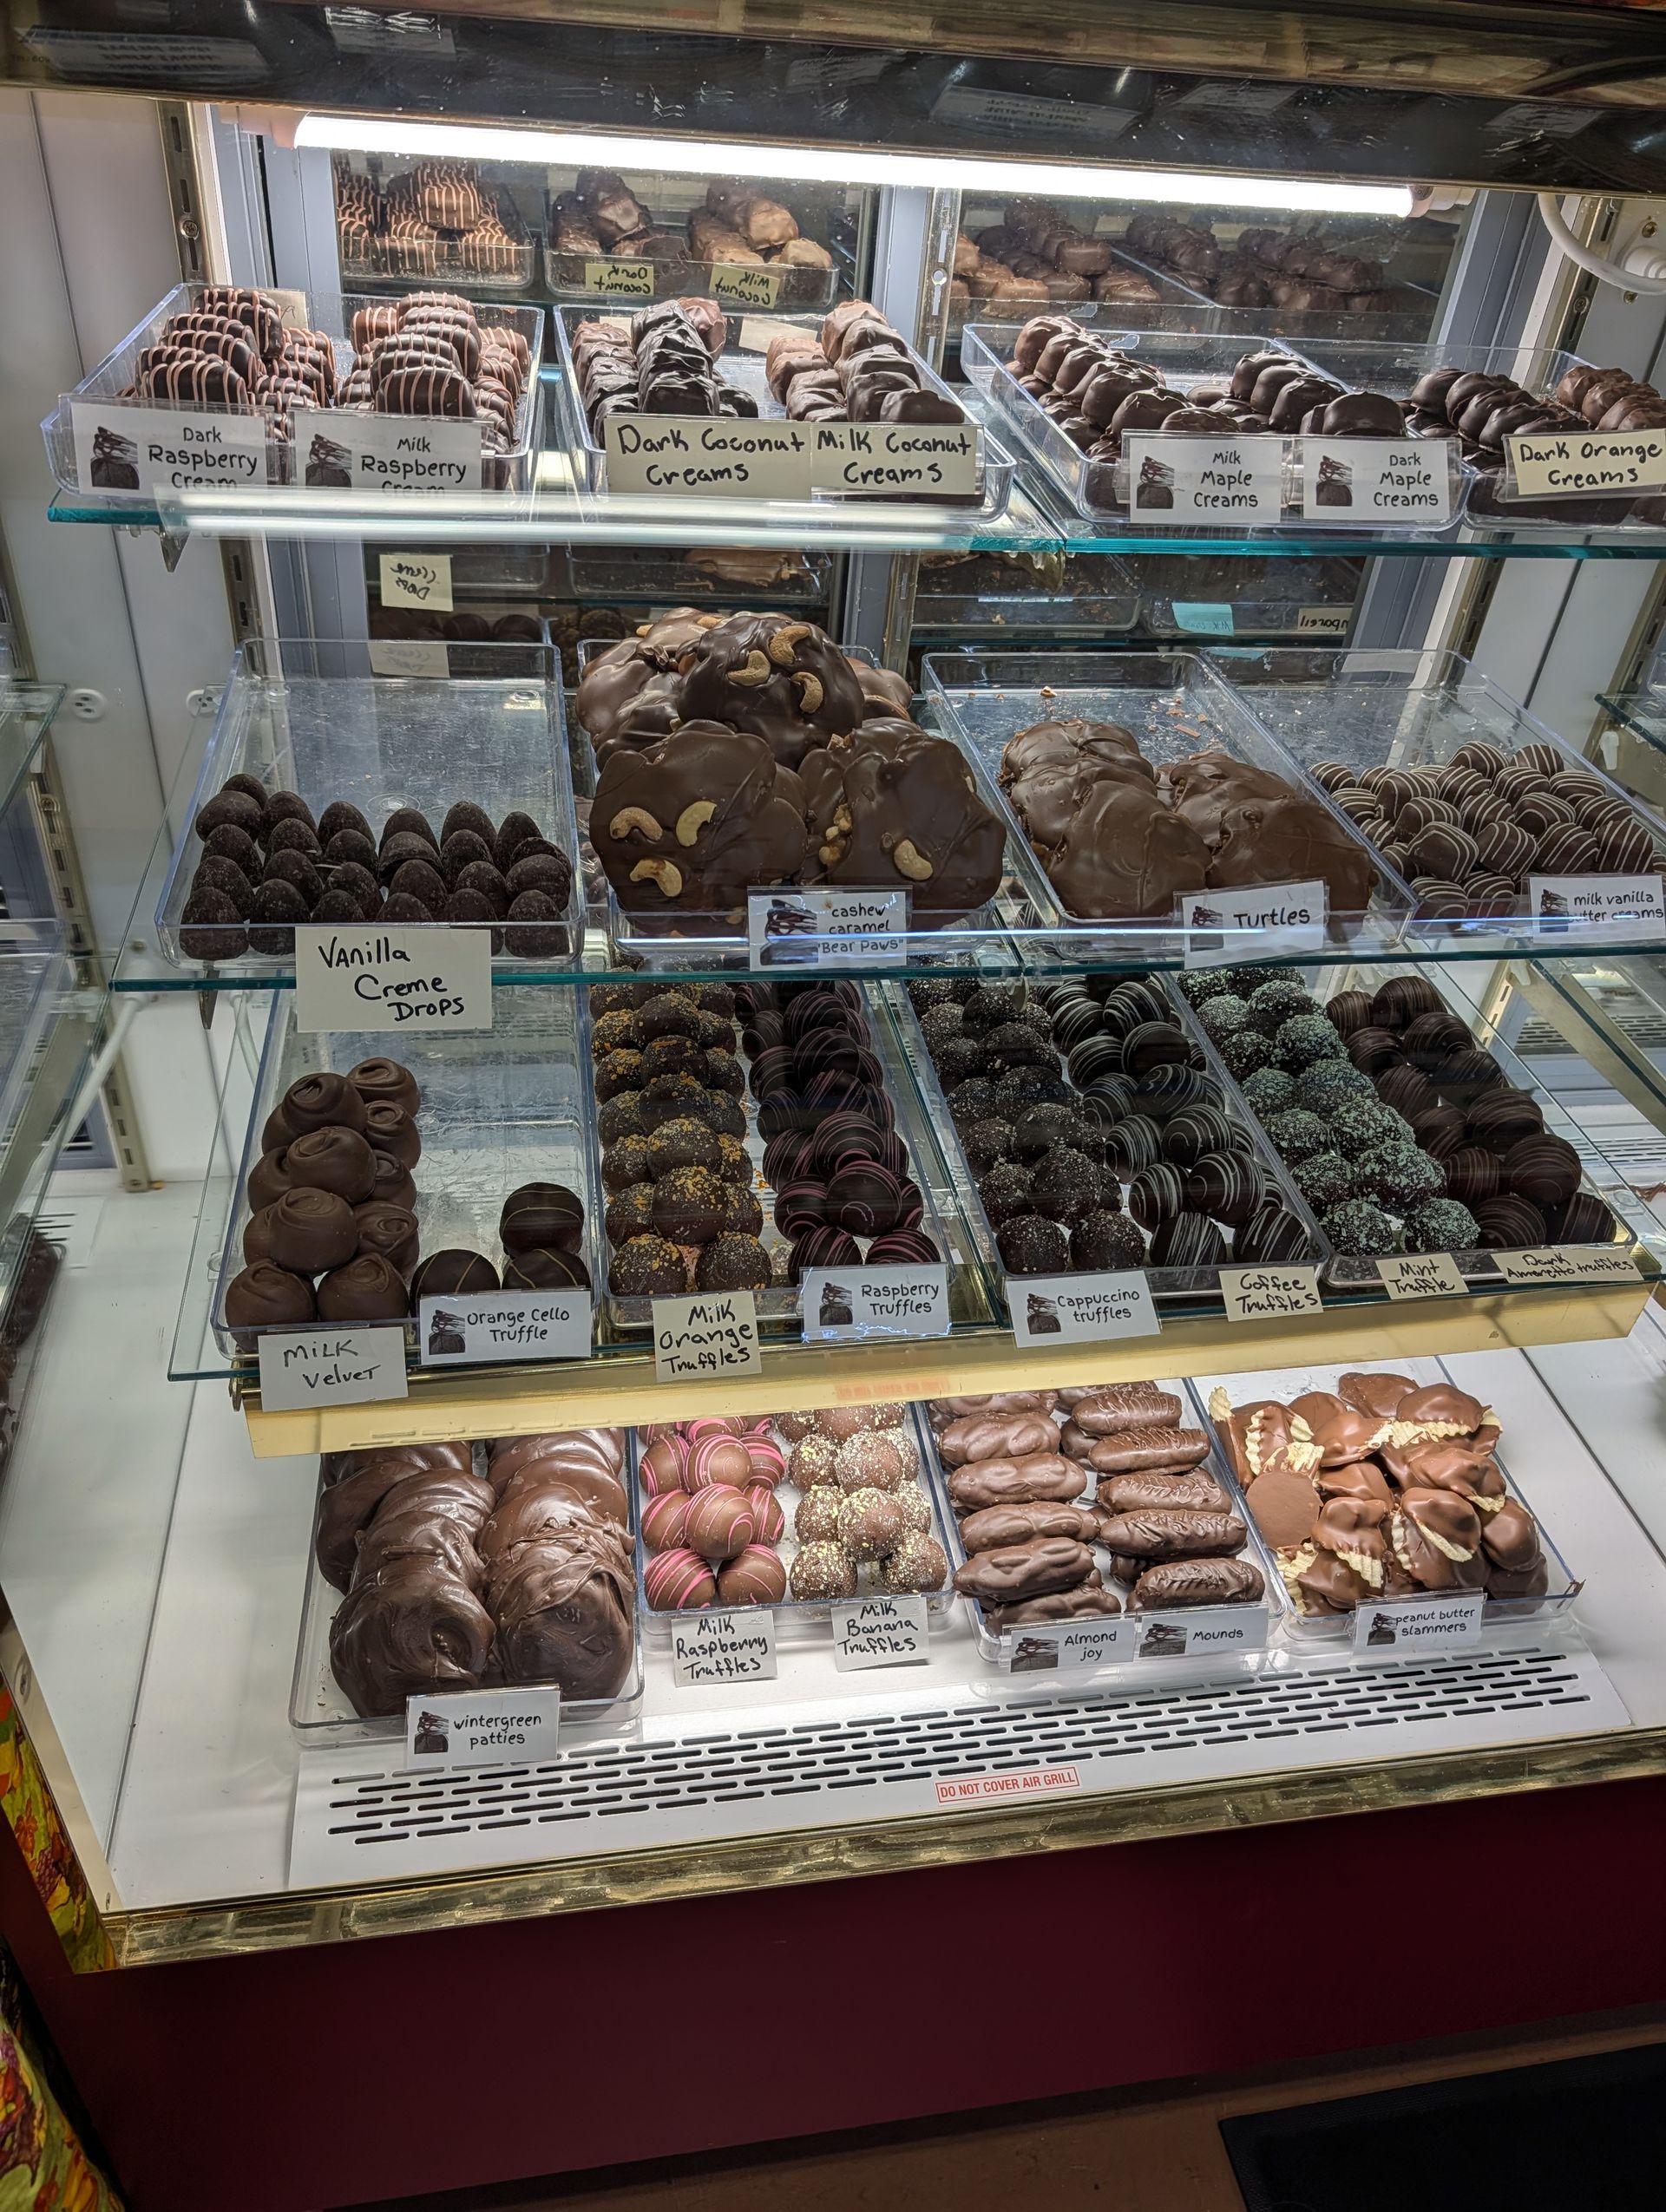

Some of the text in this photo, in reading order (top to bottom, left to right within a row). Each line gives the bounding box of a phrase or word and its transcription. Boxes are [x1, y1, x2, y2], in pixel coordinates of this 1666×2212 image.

[183, 426, 222, 443] Dark
[617, 424, 805, 456] Dark Coconut
[817, 428, 972, 456] Milk Coconut
[397, 436, 431, 453] Milk
[1519, 441, 1663, 463] Dark Orange
[148, 444, 258, 475] Raspberry
[1212, 450, 1242, 465] Milk
[1389, 453, 1421, 467] Dark
[361, 455, 467, 483] Raspberry
[646, 462, 750, 486] Creams
[843, 461, 943, 485] Creams
[1547, 468, 1639, 488] Creams
[1201, 469, 1252, 490] Maple
[1380, 470, 1432, 491] Maple
[1193, 492, 1258, 508] Creams
[1373, 491, 1440, 507] Creams
[1574, 891, 1655, 906] milk vanilla
[831, 902, 886, 918] cashew
[1233, 907, 1311, 929] Turtles
[829, 919, 891, 935] caramel
[354, 973, 448, 1000] Creme
[1399, 1259, 1440, 1278] Mint
[1522, 1253, 1571, 1266] Dark
[1577, 1257, 1634, 1273] truffles
[861, 1282, 940, 1300] Raspberry
[1240, 1273, 1307, 1292] Coffee
[1388, 1276, 1455, 1294] Truffle
[1057, 1288, 1140, 1309] Cappuccino
[1235, 1293, 1319, 1315] Truffles
[466, 1306, 570, 1327] Orange Cello
[687, 1299, 737, 1326] Milk
[869, 1300, 933, 1317] Truffles
[1072, 1307, 1131, 1324] truffles
[489, 1325, 548, 1344] Truffle
[659, 1323, 753, 1351] Orange
[661, 1346, 751, 1373] Truffles
[860, 1601, 897, 1620] Milk
[1395, 1608, 1475, 1626] peanut butter
[697, 1615, 735, 1635] Milk
[847, 1619, 919, 1636] Banana
[1192, 1628, 1243, 1640] Mounds
[1401, 1622, 1467, 1636] slammers
[677, 1636, 768, 1659] Raspberry
[837, 1636, 916, 1656] Truffles
[1065, 1630, 1118, 1646] Almond
[1080, 1647, 1103, 1661] joy
[683, 1657, 762, 1679] Truffles
[453, 1714, 541, 1731] wintergreen
[469, 1731, 526, 1750] patties
[941, 1772, 1076, 1798] DO NOT COVER AIR GRILL
